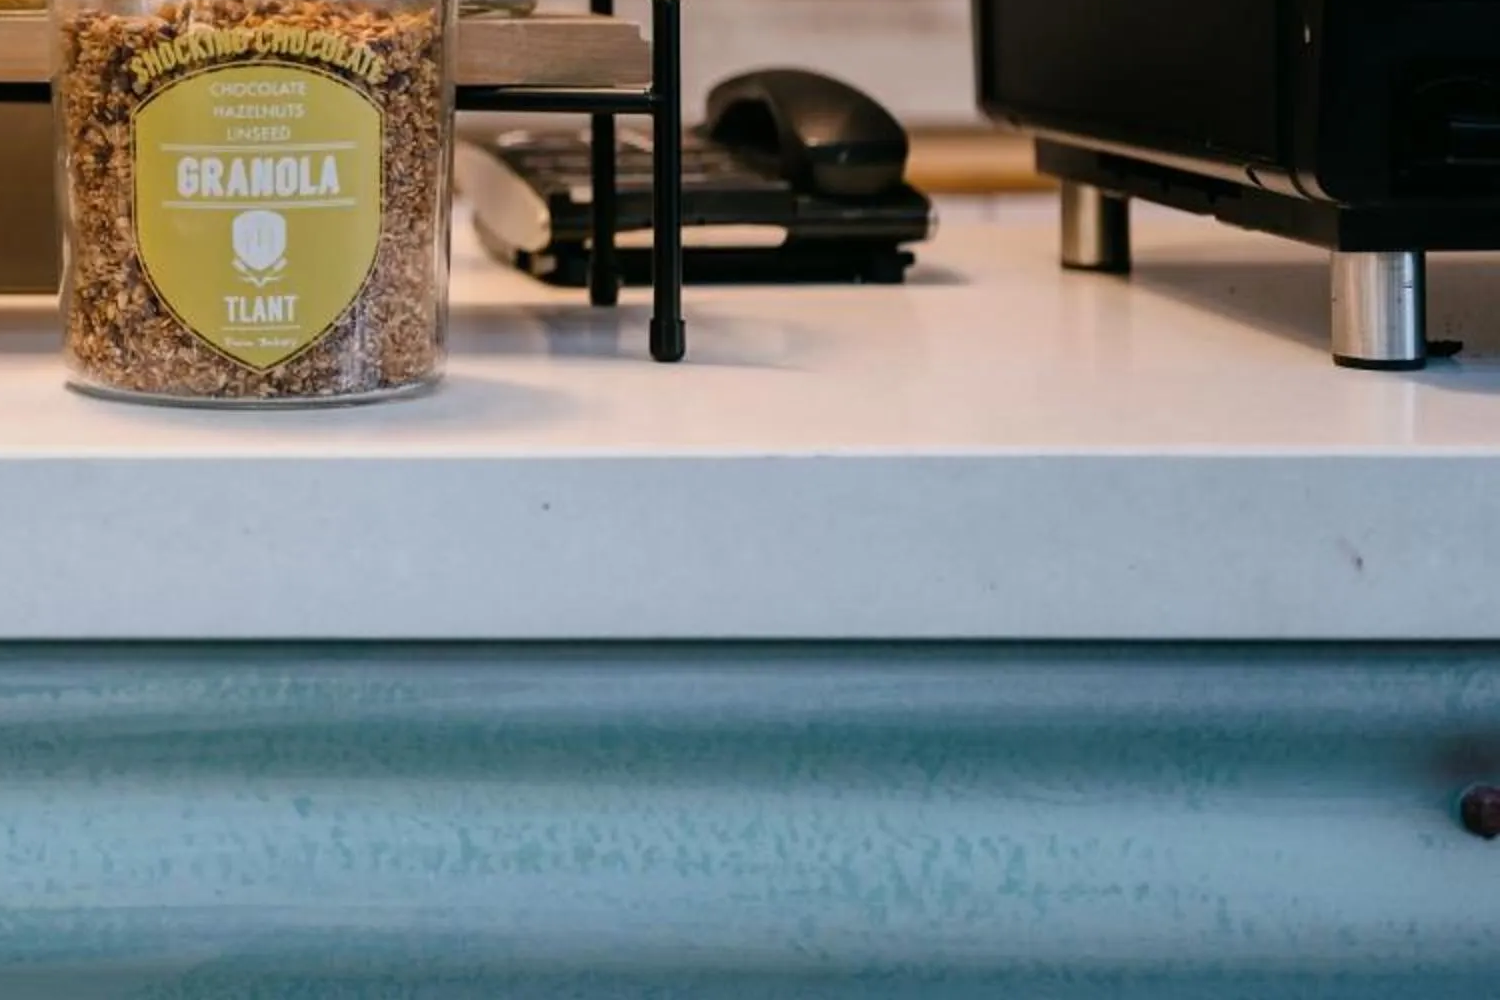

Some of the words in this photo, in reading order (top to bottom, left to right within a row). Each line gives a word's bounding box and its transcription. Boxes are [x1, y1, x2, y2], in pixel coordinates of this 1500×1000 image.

[130, 28, 247, 86] SHOCKING
[254, 26, 388, 85] CHOCOLATE
[209, 81, 307, 97] CHOCOLATE
[212, 102, 306, 119] HAZELNUTS
[226, 125, 292, 141] LINSEED
[176, 155, 341, 198] GRANOLA
[223, 295, 299, 322] TLANT
